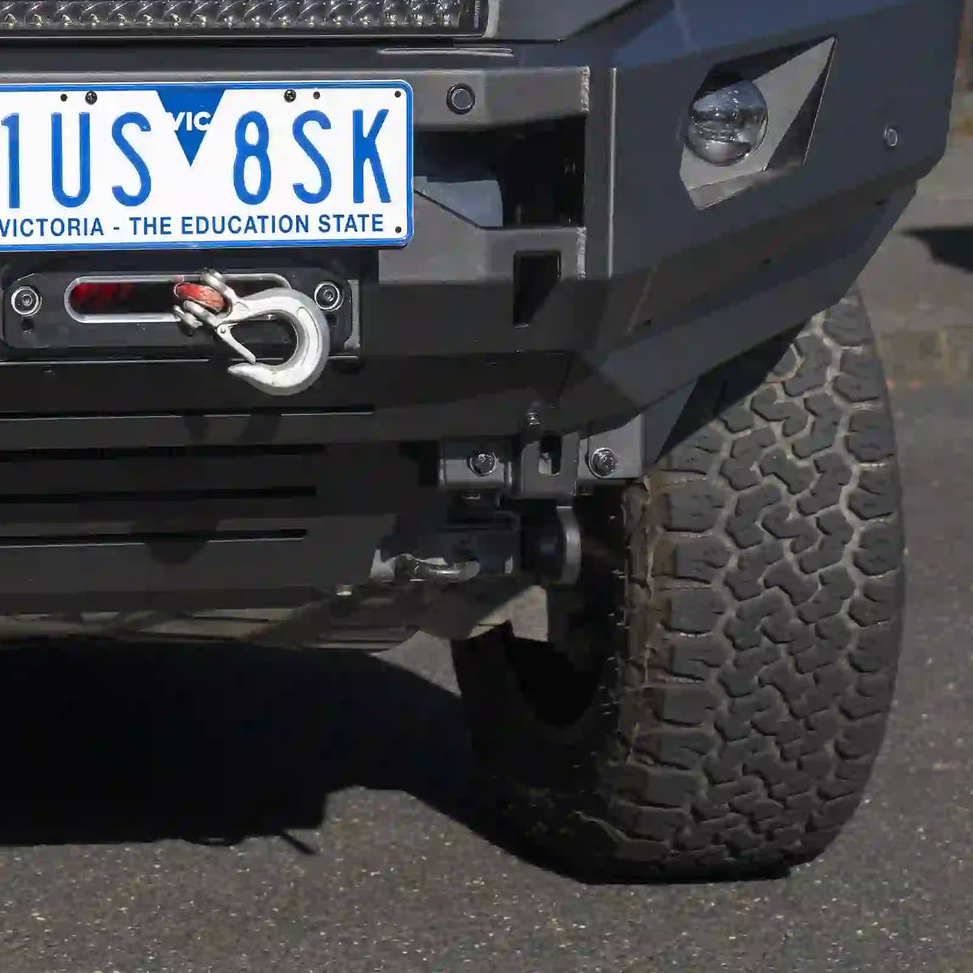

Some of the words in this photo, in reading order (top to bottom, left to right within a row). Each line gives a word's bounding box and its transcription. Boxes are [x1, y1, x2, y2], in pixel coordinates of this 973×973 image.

[165, 111, 211, 131] VIC
[1, 112, 152, 209] 1US
[233, 109, 391, 205] 8SK
[130, 216, 172, 235] THE
[181, 215, 309, 235] EDUCATION
[319, 213, 384, 233] STATE
